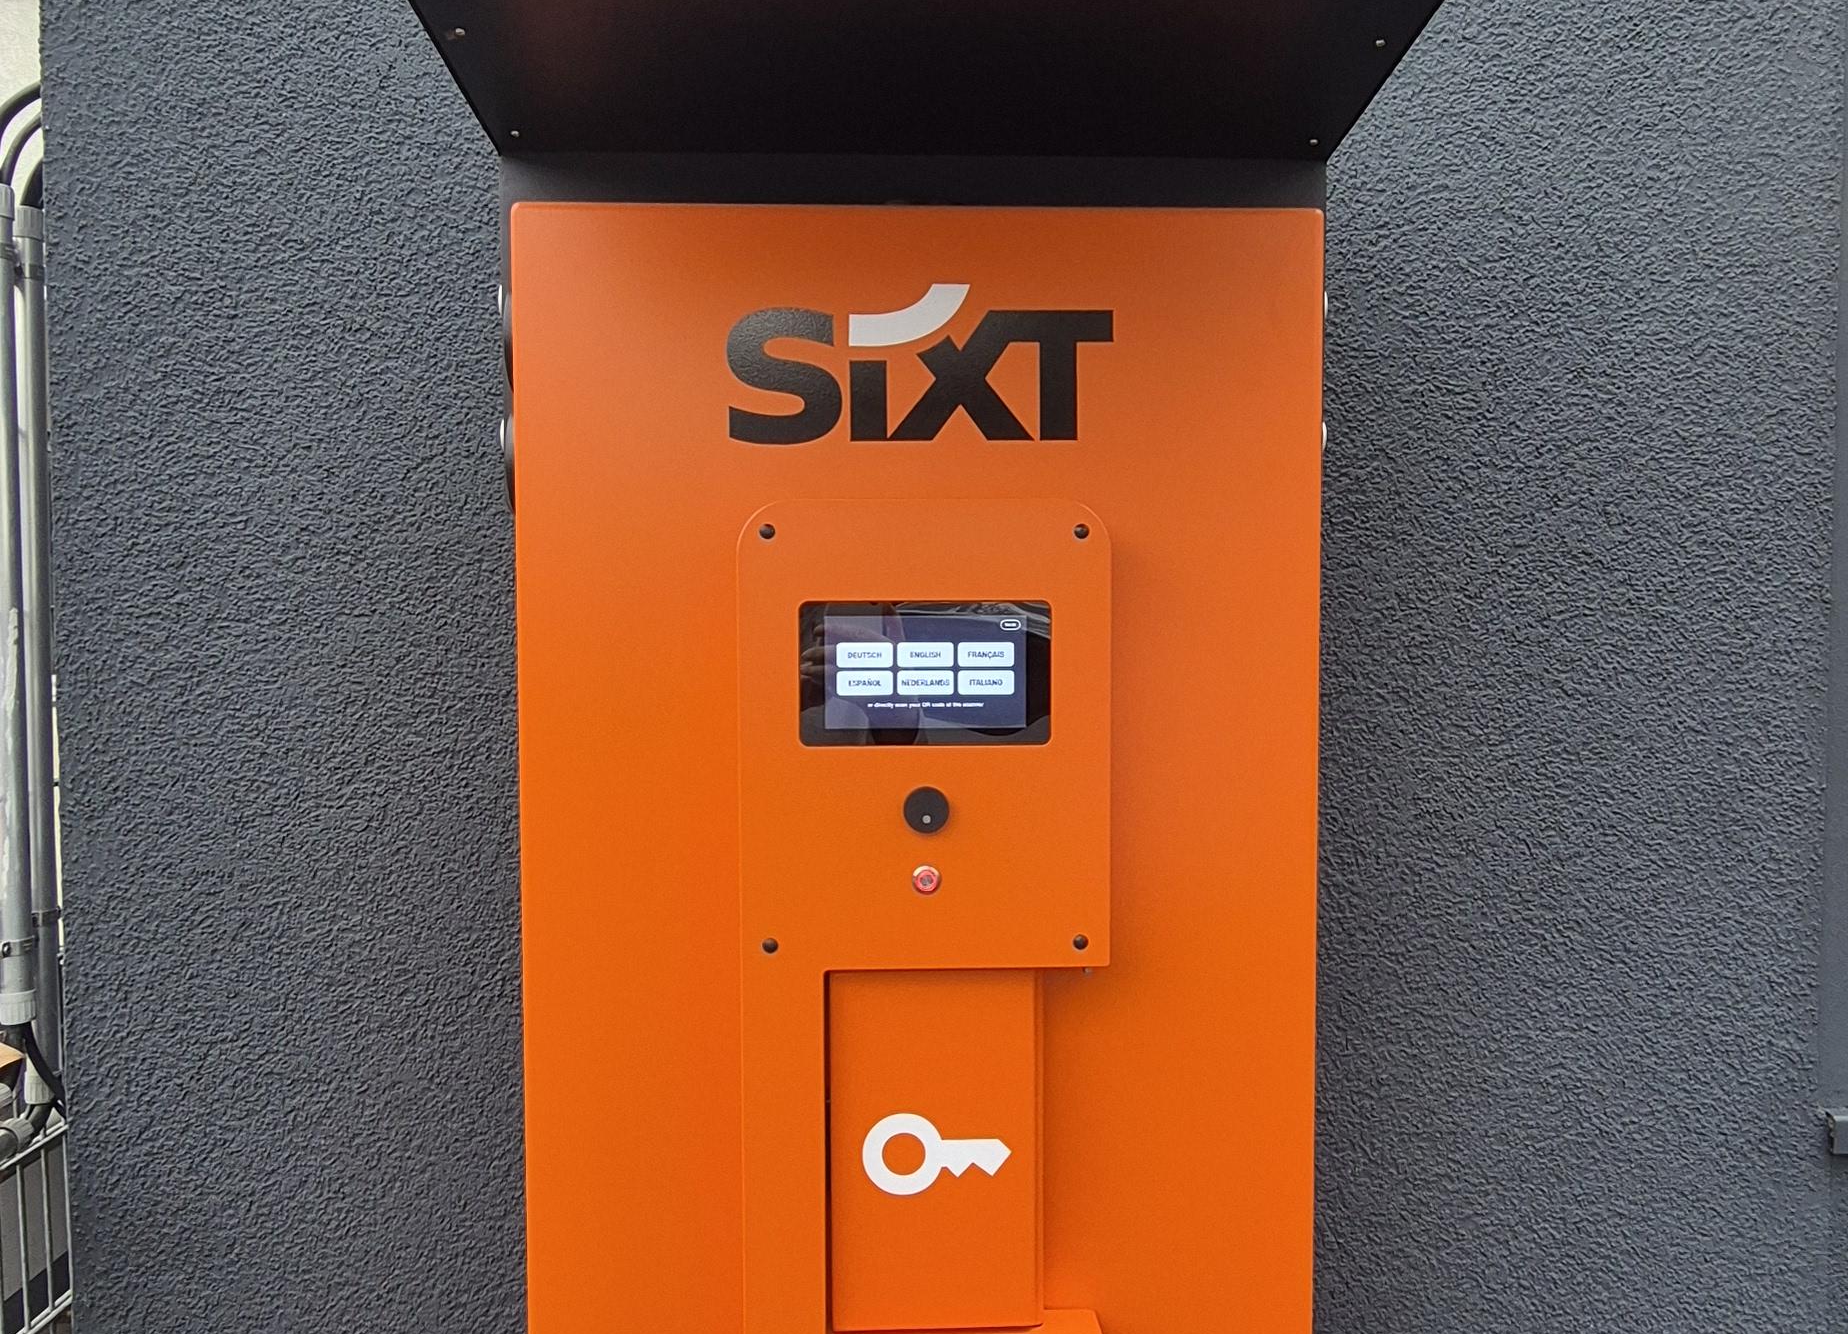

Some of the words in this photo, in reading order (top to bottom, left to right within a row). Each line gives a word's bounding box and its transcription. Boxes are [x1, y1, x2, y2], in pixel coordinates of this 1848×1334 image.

[967, 651, 1005, 660] FRANÇAIS
[848, 678, 881, 687] ESPAÑOL
[901, 679, 950, 687] NEDERLANDS
